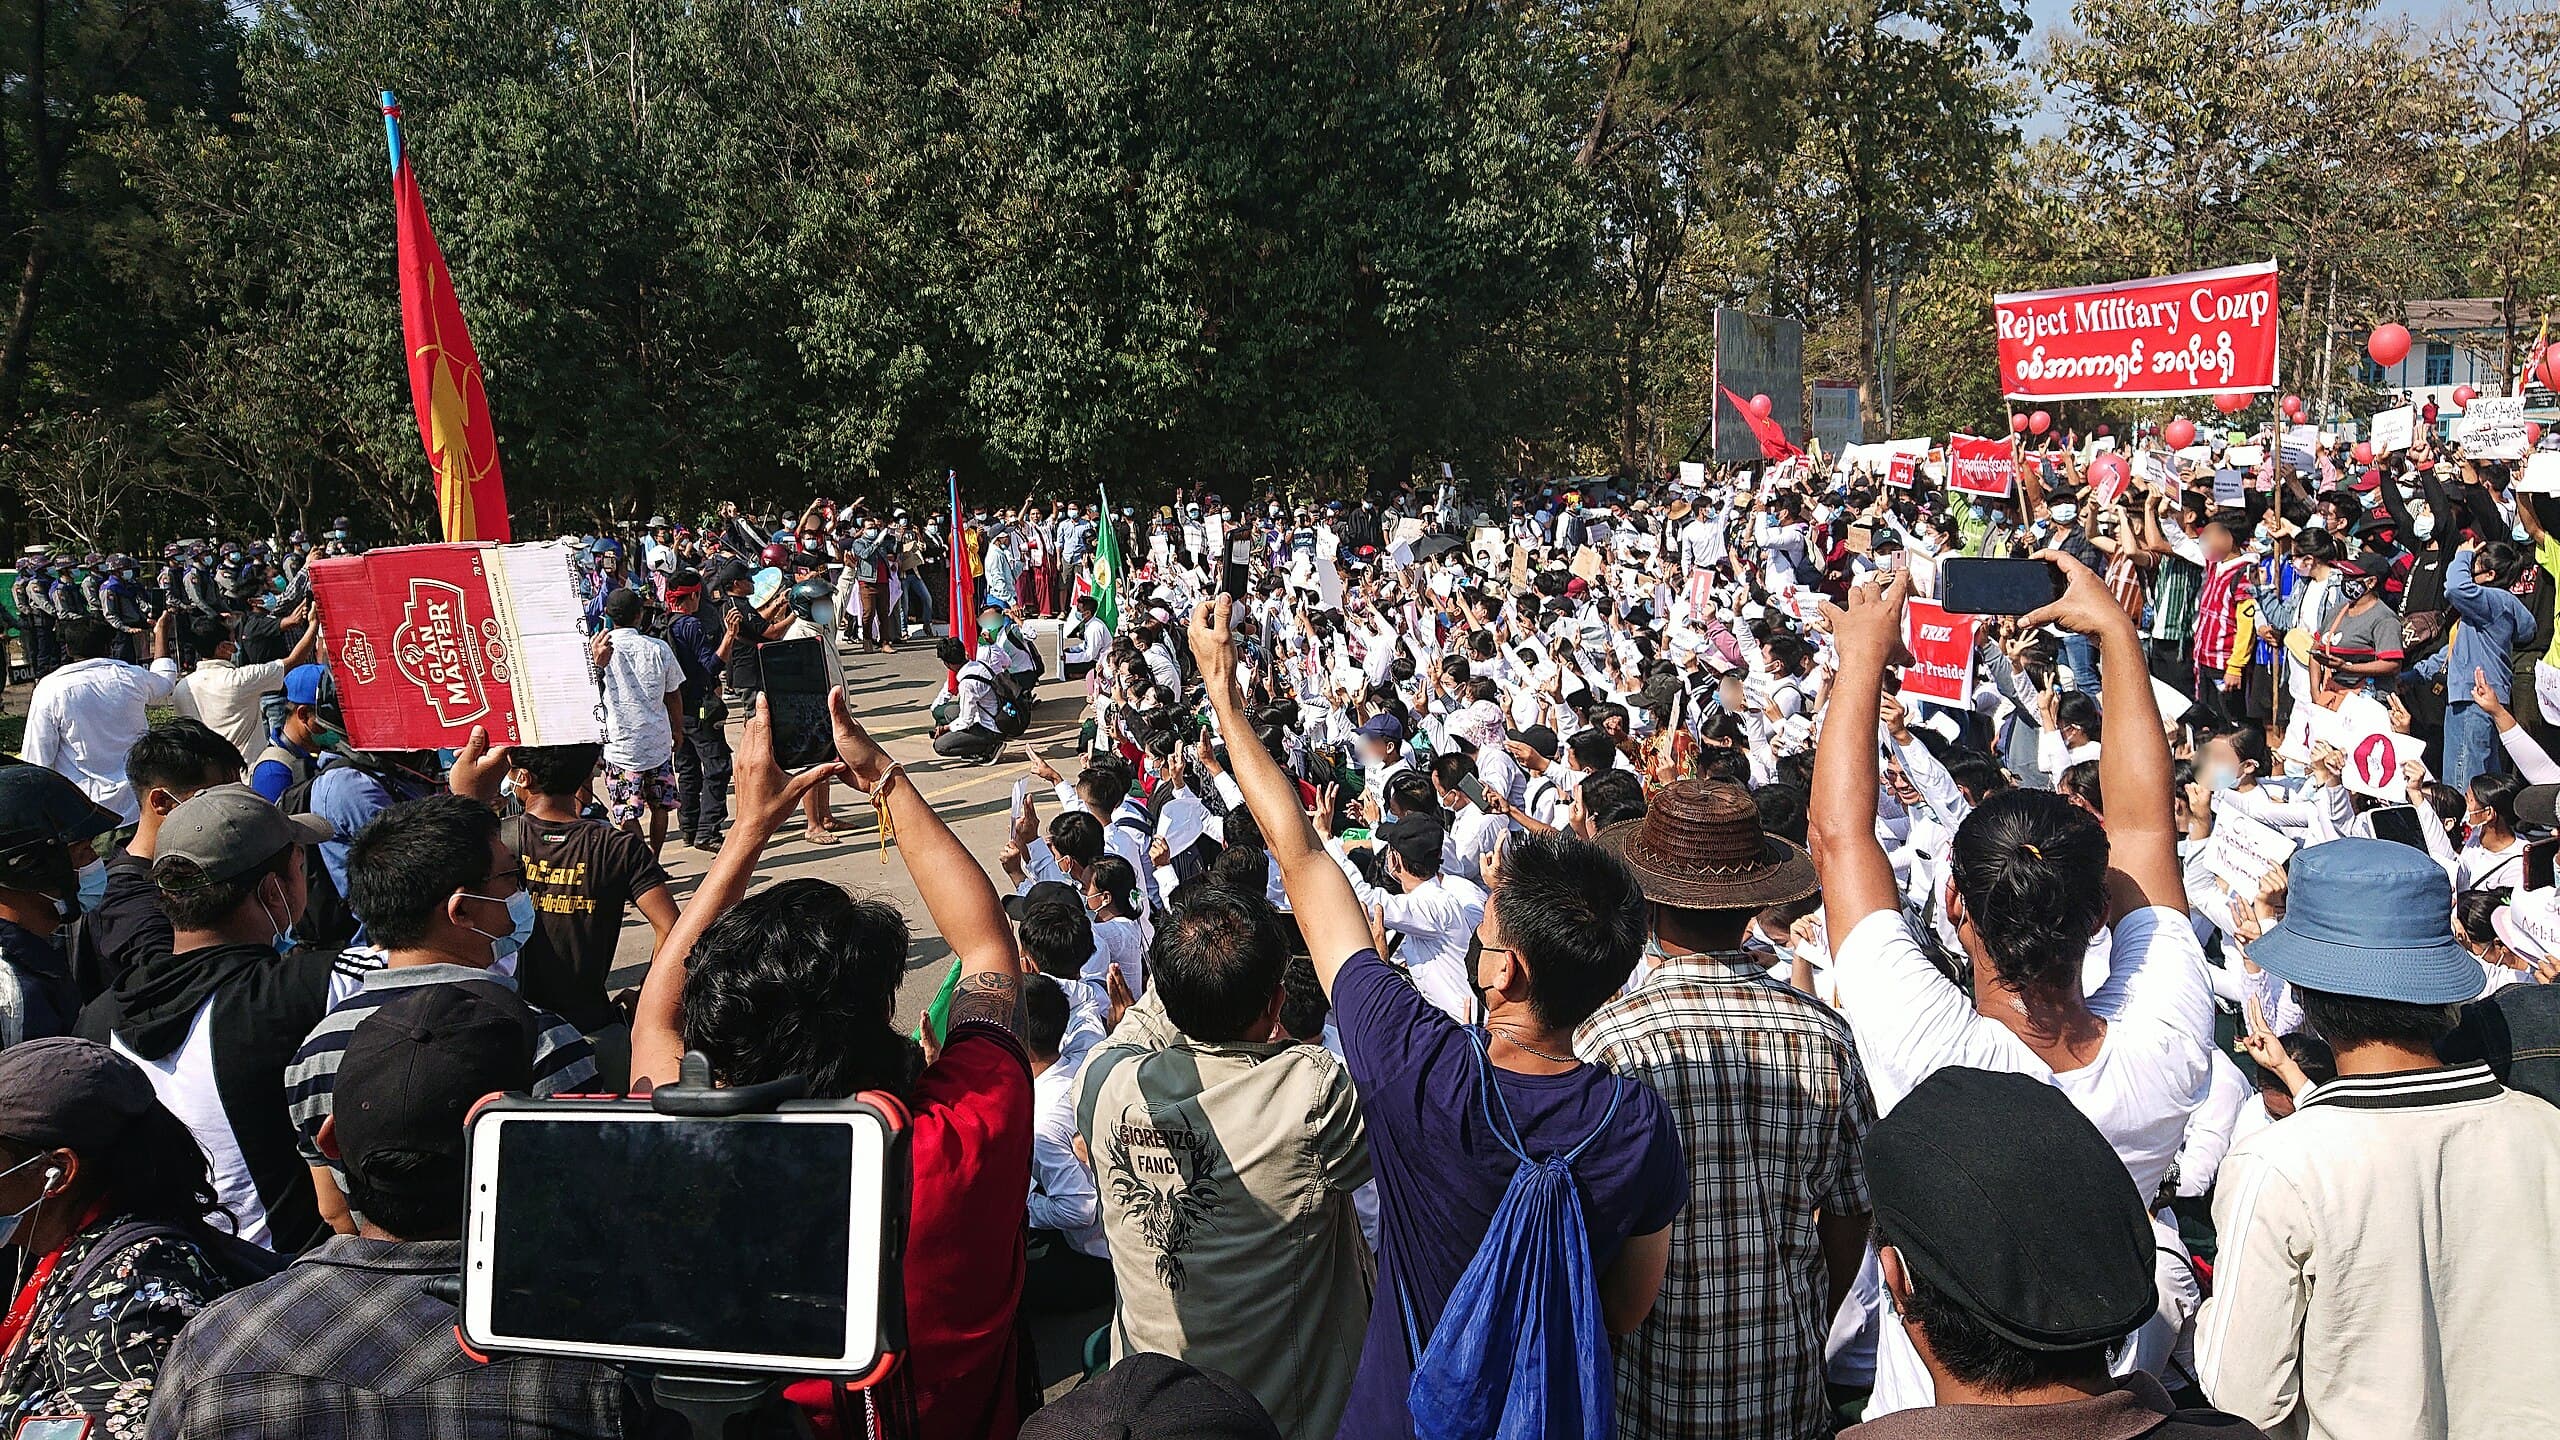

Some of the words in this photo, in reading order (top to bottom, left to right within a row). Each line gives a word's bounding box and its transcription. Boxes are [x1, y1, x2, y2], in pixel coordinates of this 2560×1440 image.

[1997, 306, 2069, 346] Reject
[2074, 296, 2181, 334] Military
[2189, 288, 2269, 327] Coup
[2016, 338, 2145, 389] စစ်အာဏာရှင်
[2150, 330, 2235, 386] အလိုမရှိ
[473, 566, 482, 577] 70
[492, 572, 503, 598] WHISKY
[355, 637, 371, 676] MASTER
[418, 625, 446, 684] GLAN
[428, 600, 471, 705] MASTER
[457, 637, 469, 667] FINEST
[1926, 660, 1966, 681] Preside
[2215, 822, 2269, 867] Disobedienc
[1118, 1124, 1198, 1151] GIORENZO
[1137, 1154, 1183, 1176] FANCY
